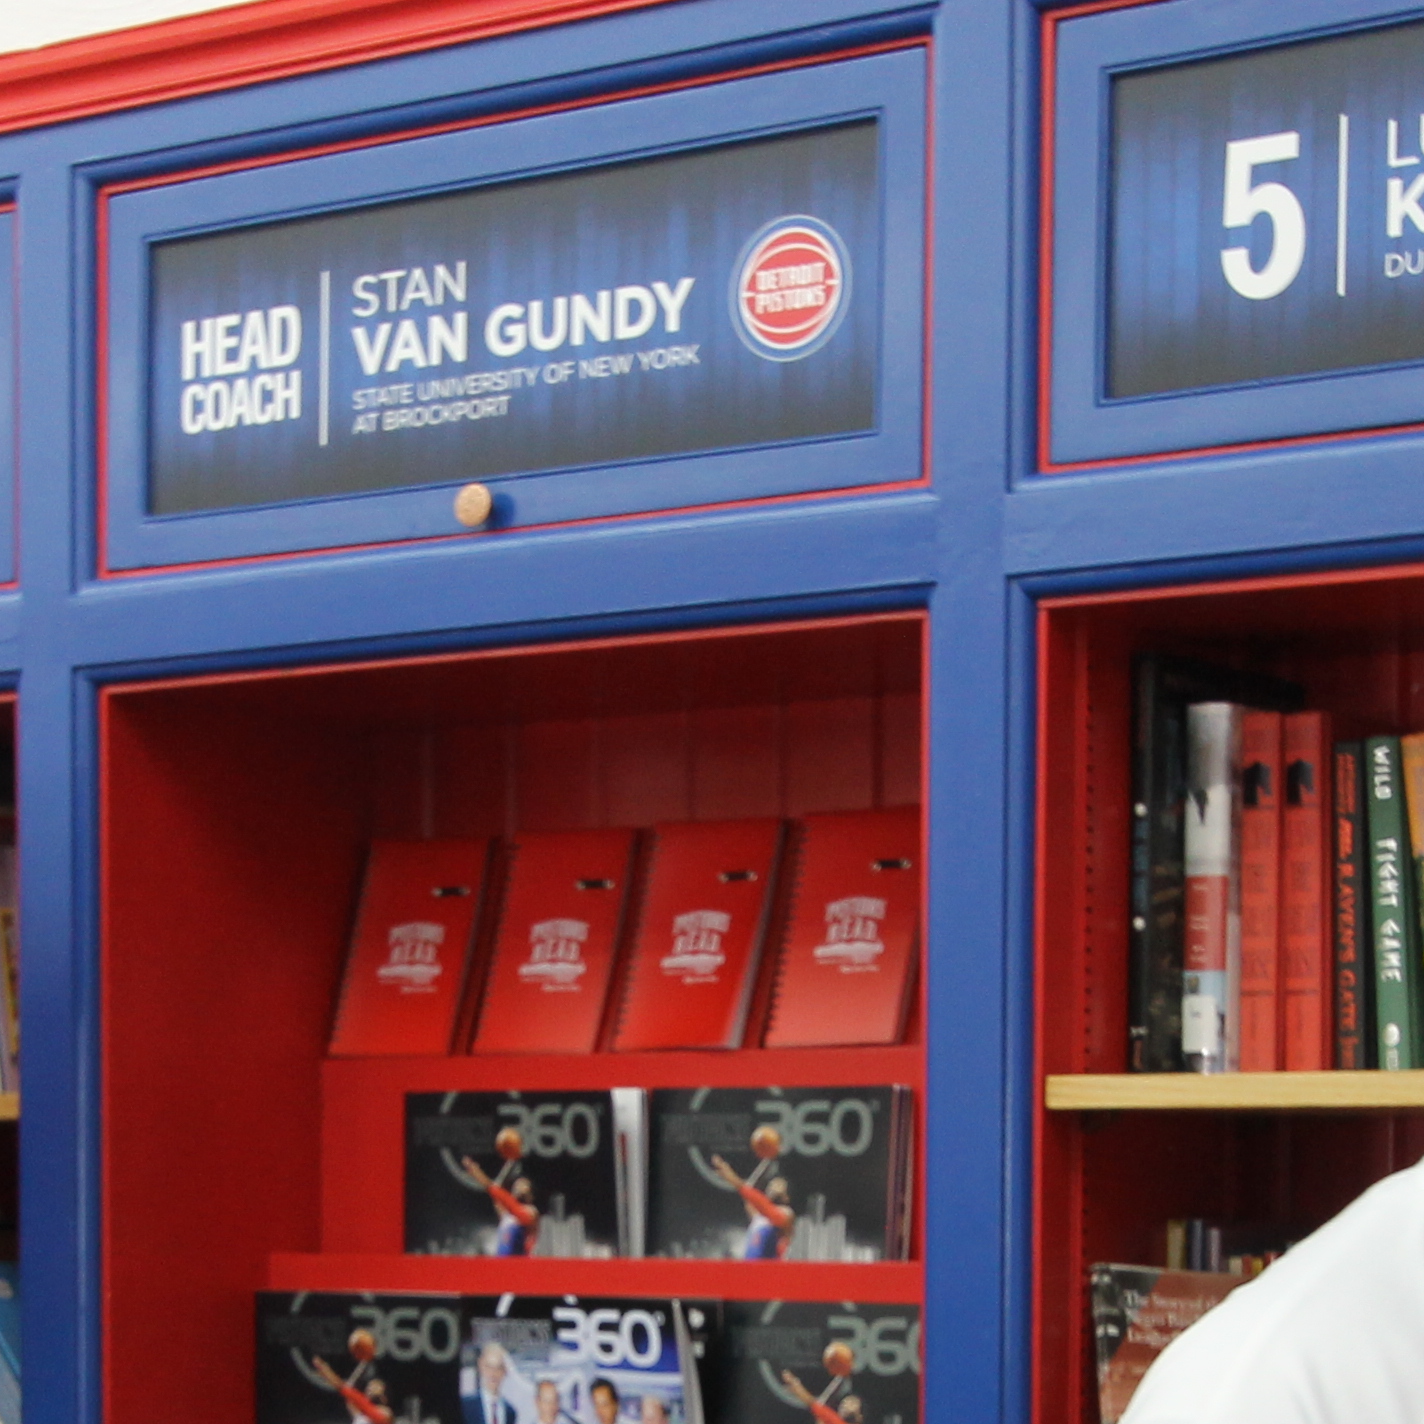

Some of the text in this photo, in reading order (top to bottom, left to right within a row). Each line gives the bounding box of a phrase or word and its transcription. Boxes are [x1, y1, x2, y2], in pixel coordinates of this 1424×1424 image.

[1220, 131, 1306, 301] 5
[351, 261, 467, 318] STAN
[181, 305, 300, 380] HEAD
[351, 277, 695, 375] VAN GUNDY
[181, 371, 301, 434] COACH
[351, 344, 701, 410] STATE UNIVERSITY OF NEW YORK
[351, 396, 511, 435] AT BROCKPORT
